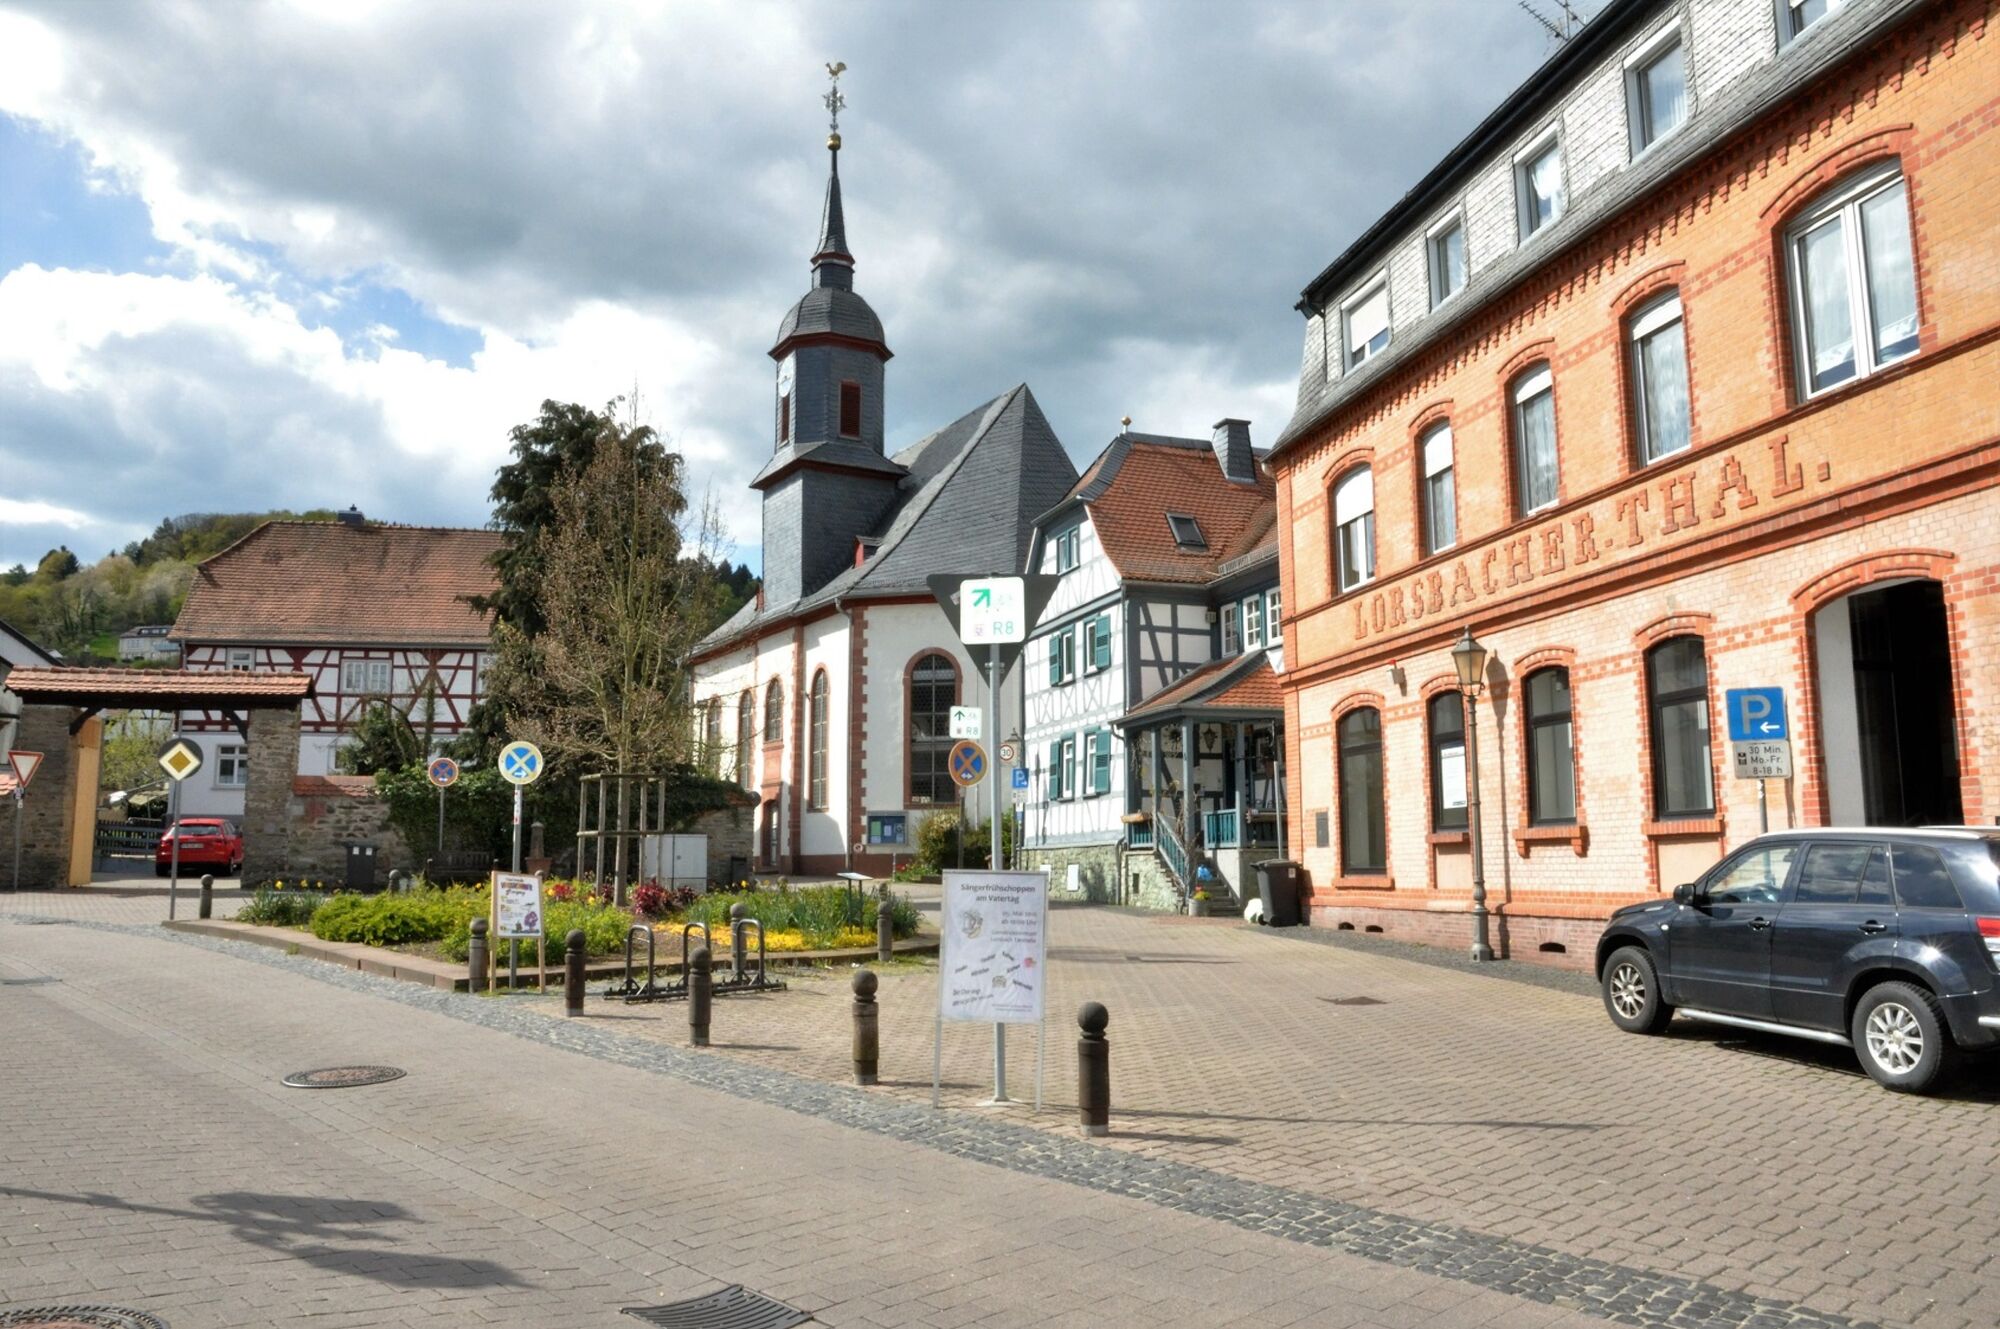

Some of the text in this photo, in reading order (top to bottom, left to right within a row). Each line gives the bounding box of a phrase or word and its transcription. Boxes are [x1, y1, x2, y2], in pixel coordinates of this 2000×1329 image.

[992, 621, 1014, 636] R8
[1740, 694, 1771, 734] P
[966, 726, 979, 736] R8
[1002, 748, 1012, 757] 30
[1748, 745, 1784, 755] 30 Min.
[1753, 766, 1783, 775] 8-18 h
[1015, 770, 1025, 787] P
[960, 884, 1036, 894] Sängerfrühschoppen
[988, 895, 1020, 904] Vatertag
